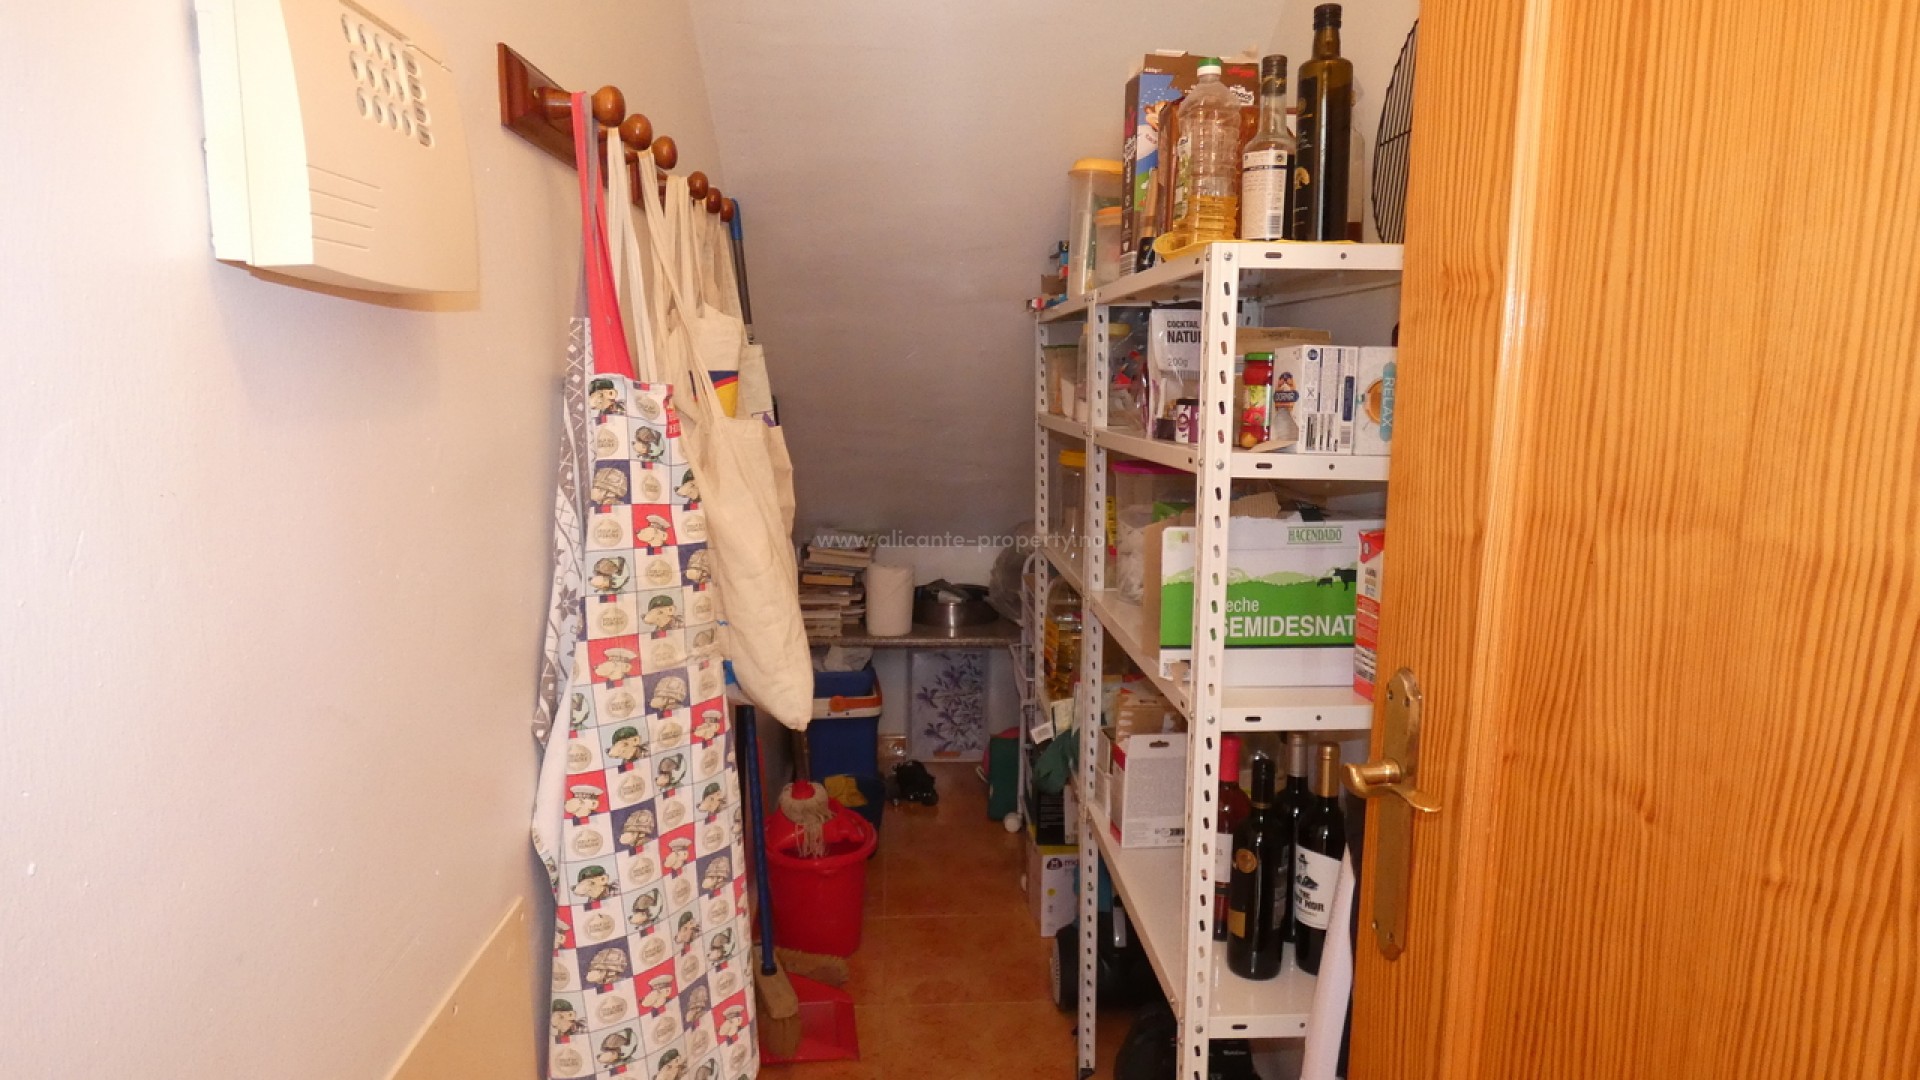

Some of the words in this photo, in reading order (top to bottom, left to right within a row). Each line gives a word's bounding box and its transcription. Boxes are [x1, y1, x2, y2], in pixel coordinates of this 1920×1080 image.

[1166, 330, 1202, 343] NATU
[1382, 377, 1396, 427] RELAX
[1287, 528, 1342, 542] HACENDADO
[1226, 596, 1260, 613] eche
